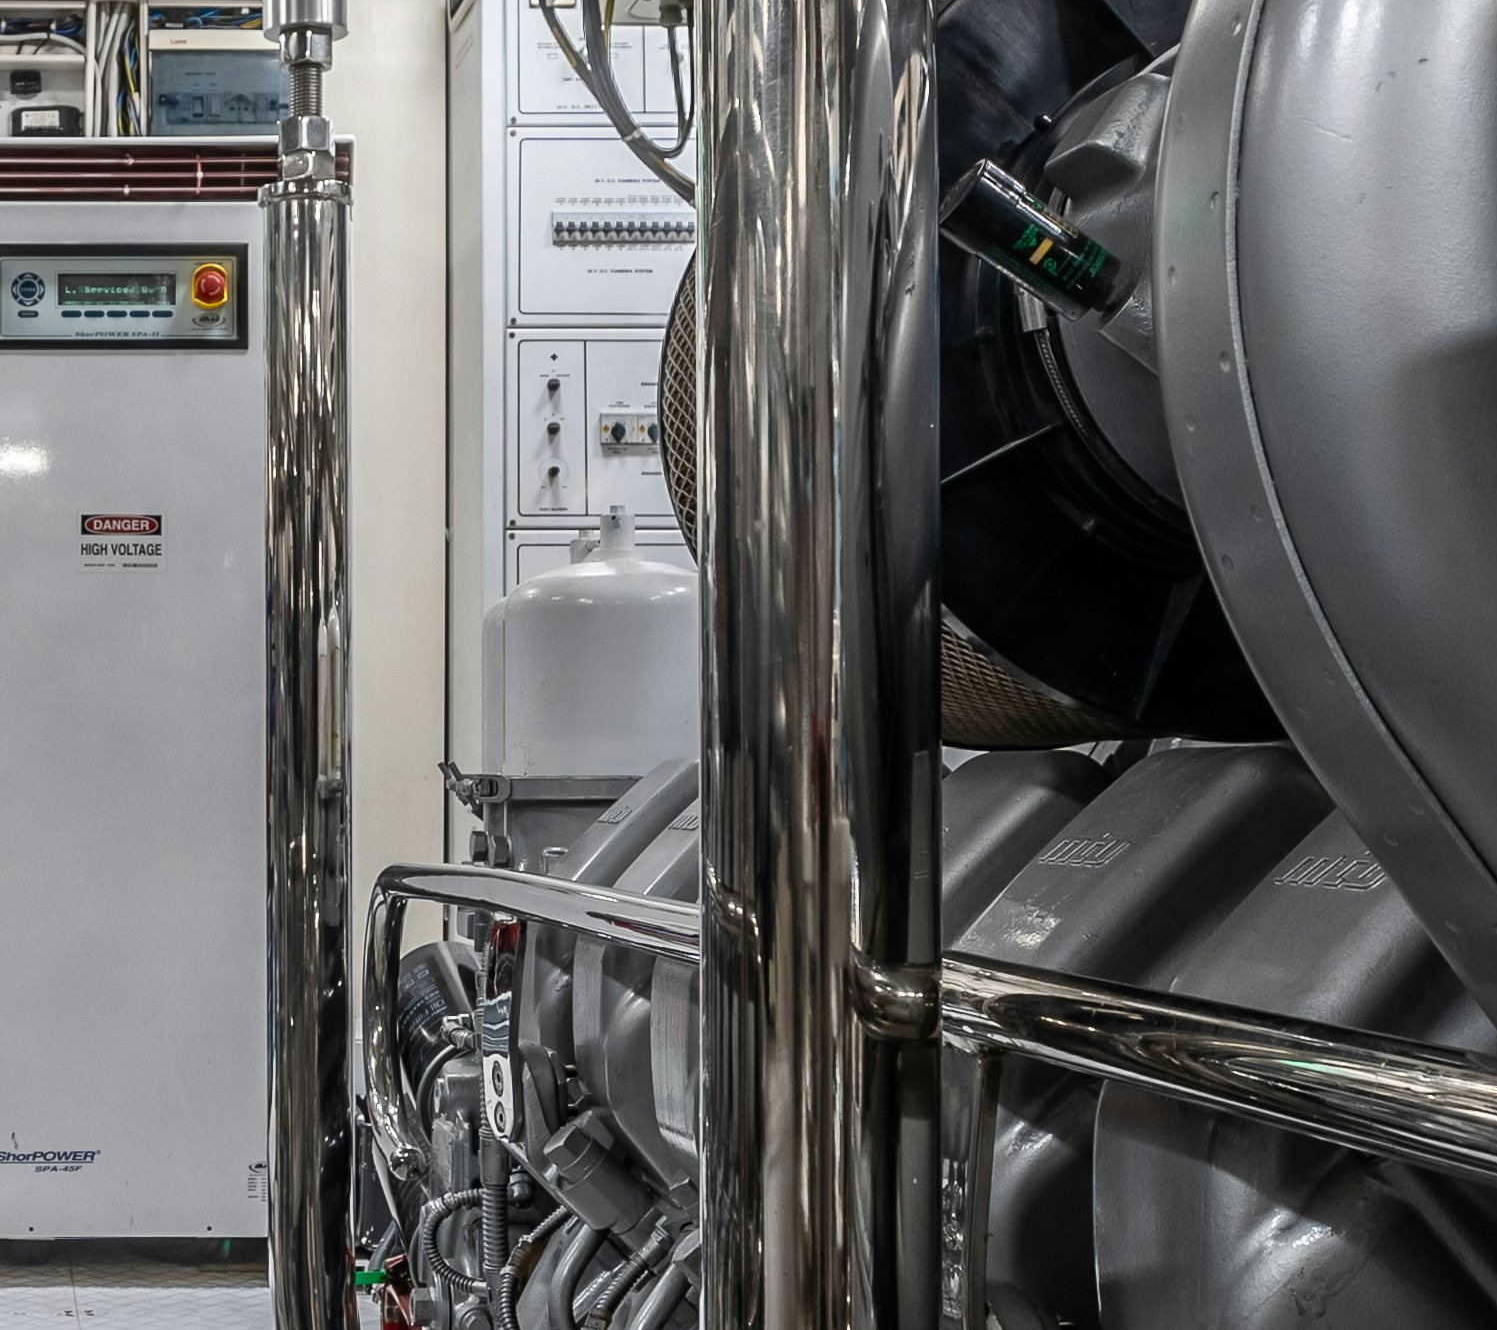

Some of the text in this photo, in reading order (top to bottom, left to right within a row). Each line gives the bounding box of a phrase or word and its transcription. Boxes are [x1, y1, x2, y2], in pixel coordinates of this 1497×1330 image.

[93, 520, 149, 531] DANGER
[81, 543, 162, 556] HIGH VOLTAGE
[35, 1165, 83, 1173] SPA-45F
